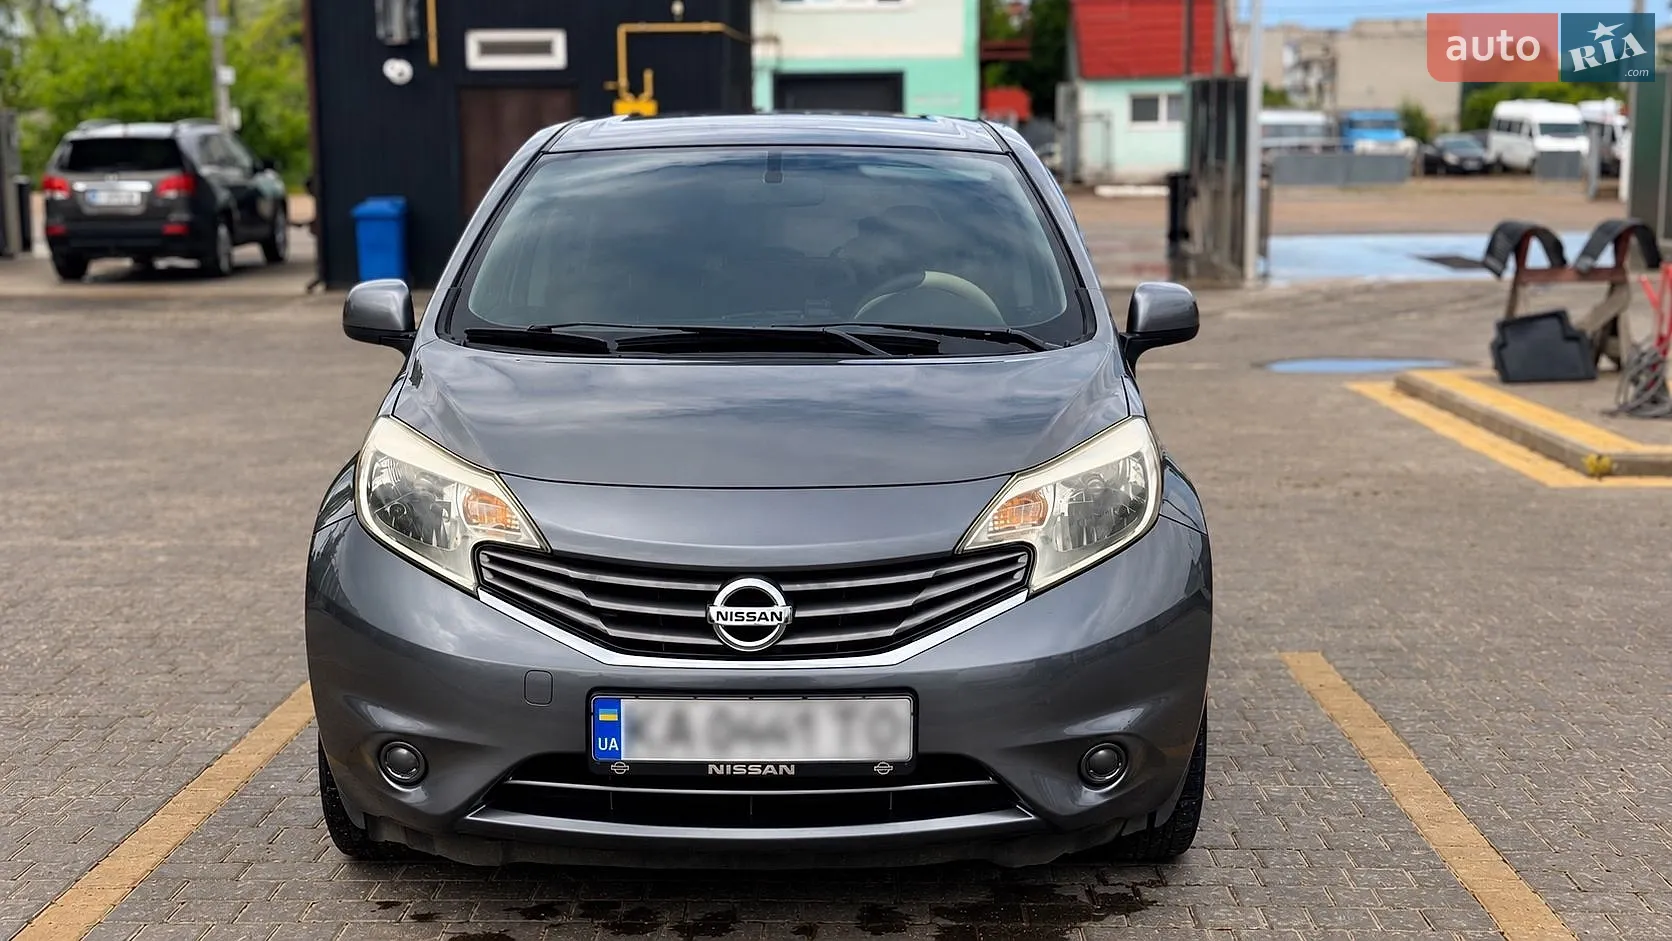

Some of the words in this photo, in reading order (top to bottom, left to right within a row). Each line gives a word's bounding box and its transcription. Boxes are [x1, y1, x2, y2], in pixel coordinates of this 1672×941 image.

[716, 611, 783, 622] NISSAN
[598, 738, 619, 751] UA
[708, 764, 795, 776] NISSAN
